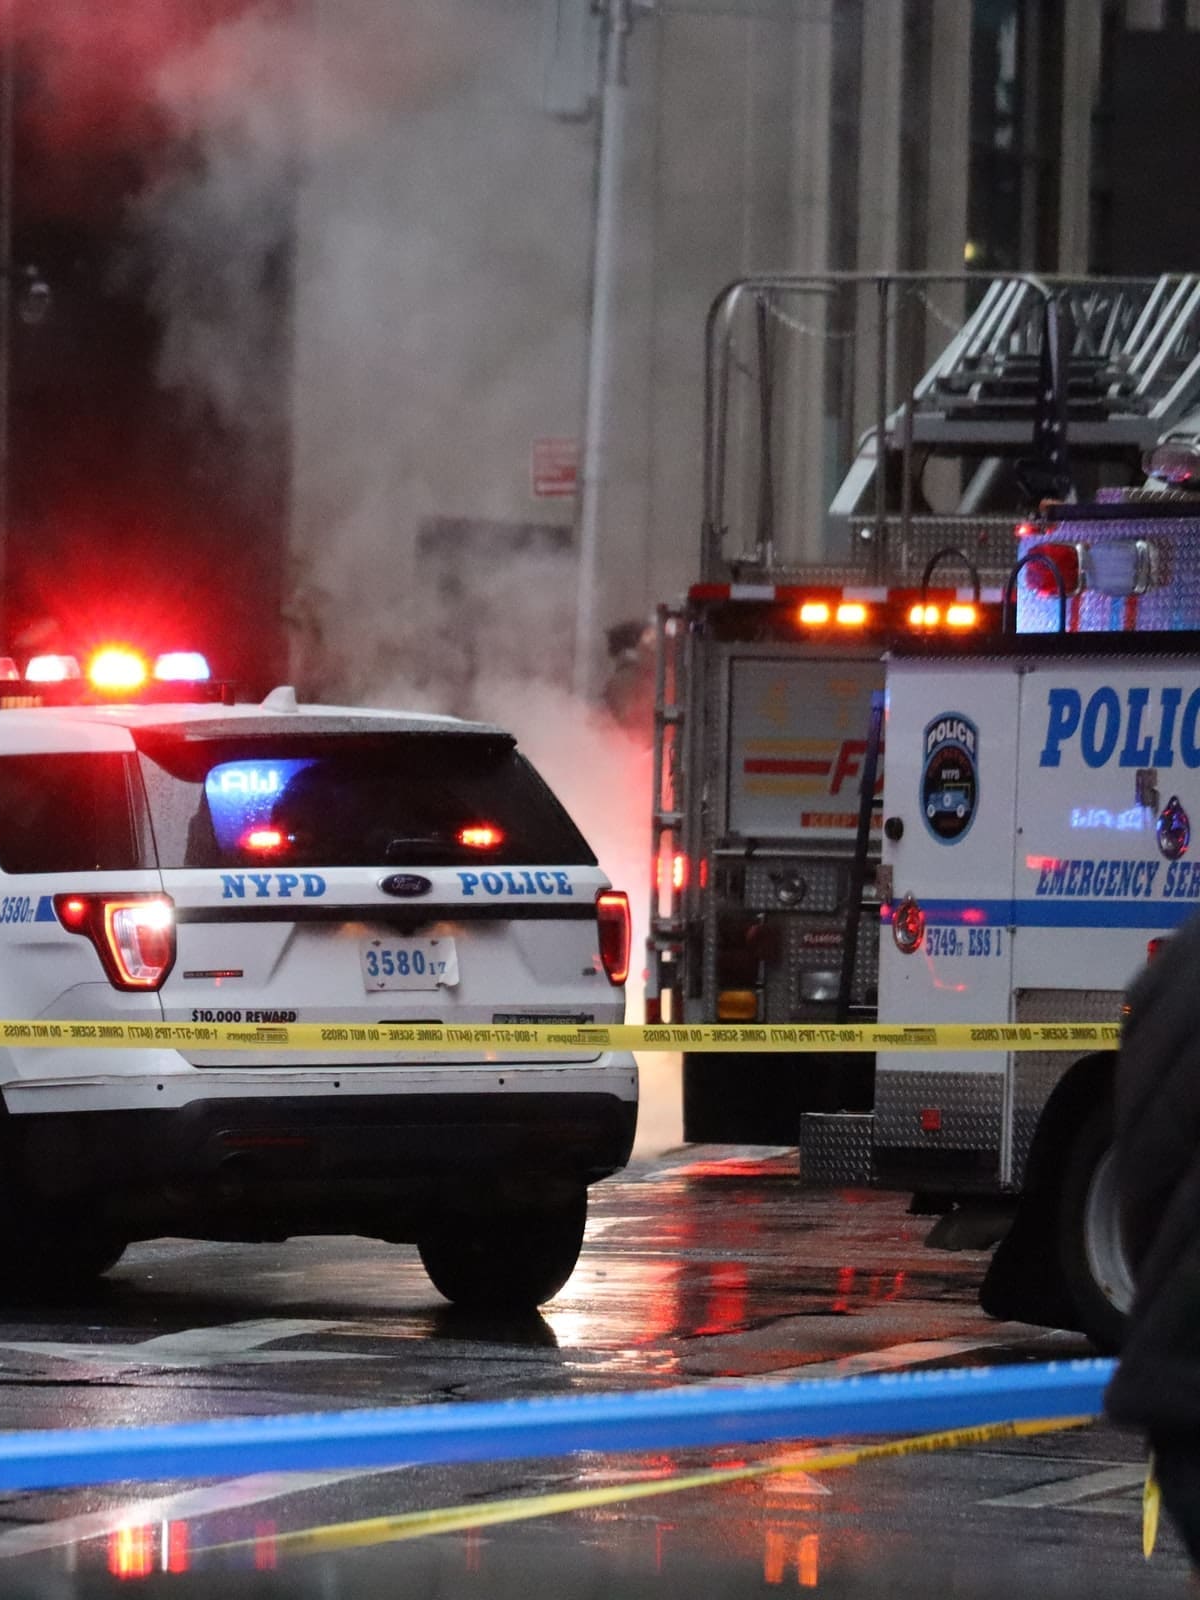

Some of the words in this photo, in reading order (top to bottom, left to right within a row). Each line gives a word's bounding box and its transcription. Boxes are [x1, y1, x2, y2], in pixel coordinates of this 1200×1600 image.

[927, 720, 975, 754] POLICE
[941, 768, 960, 780] NYPD
[220, 873, 326, 898] NYPD
[457, 871, 573, 896] POLICE
[1036, 860, 1160, 897] EMERGENCY
[968, 929, 991, 956] ESS
[996, 929, 1002, 956] 1
[191, 1010, 242, 1023] $10,000
[246, 1010, 297, 1023] REWARD
